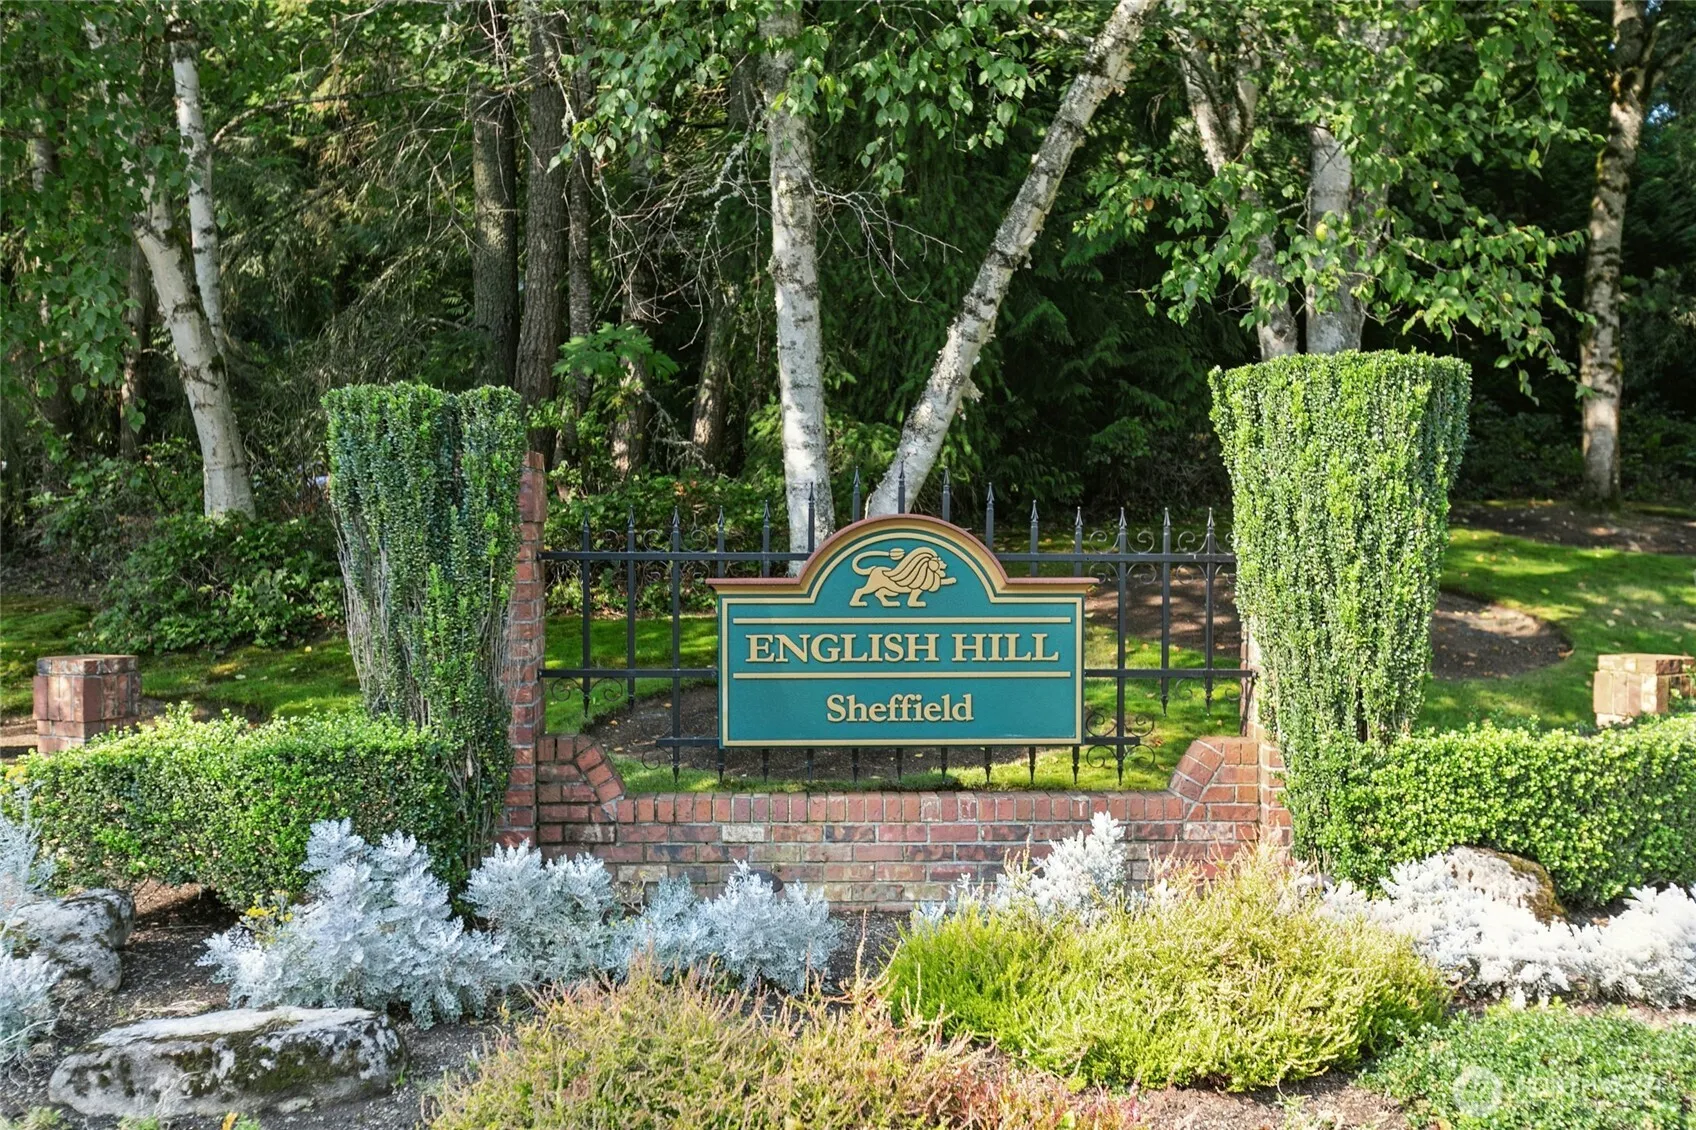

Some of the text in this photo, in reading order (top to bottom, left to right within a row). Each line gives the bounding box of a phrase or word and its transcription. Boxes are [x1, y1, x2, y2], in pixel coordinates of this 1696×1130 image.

[745, 633, 1059, 663] ENGLISH HILL
[826, 693, 974, 723] Sheffield
